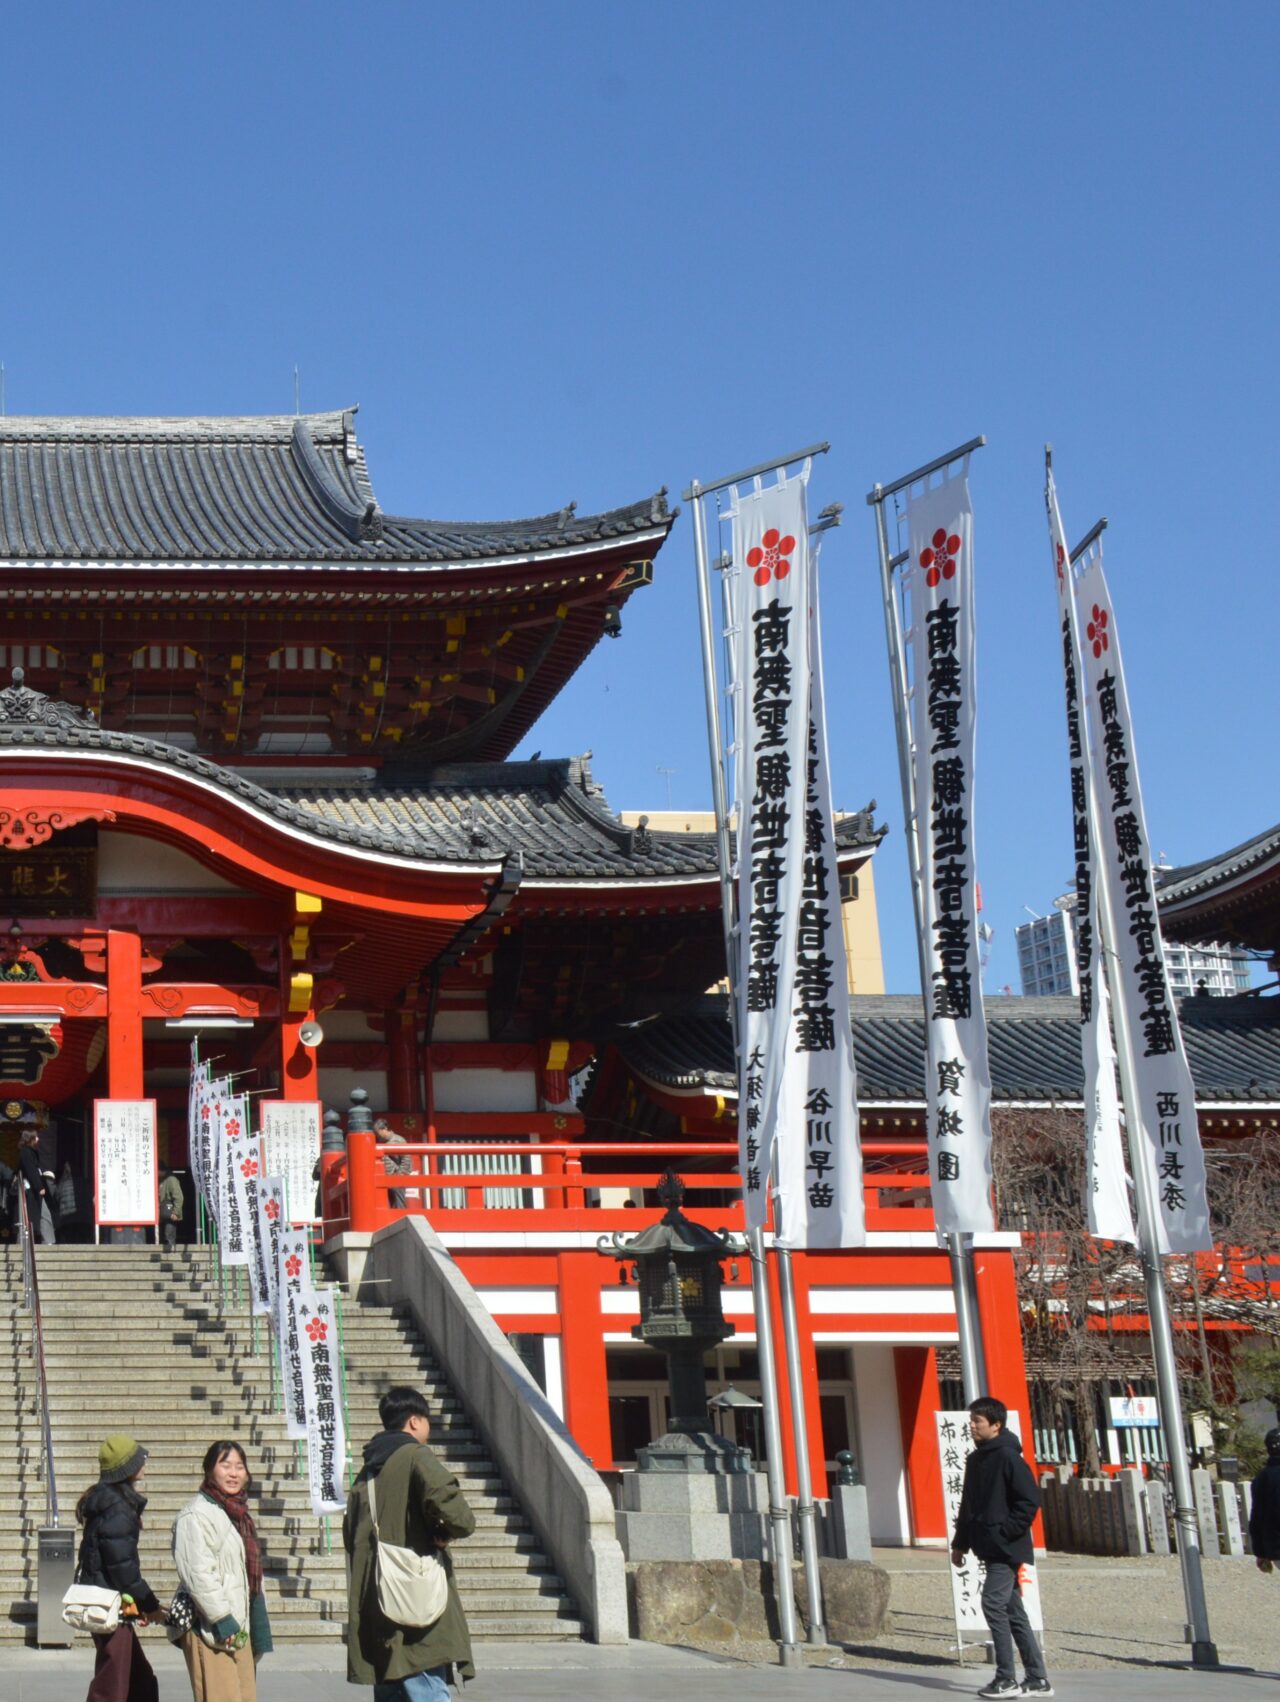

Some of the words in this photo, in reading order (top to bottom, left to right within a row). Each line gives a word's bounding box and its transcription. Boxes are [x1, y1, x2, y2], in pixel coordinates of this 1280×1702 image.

[236, 1147, 259, 1160] 奉納
[281, 1243, 304, 1254] 奉納
[299, 1304, 329, 1317] 奉納
[311, 1343, 338, 1501] 南無聖観世音菩薩
